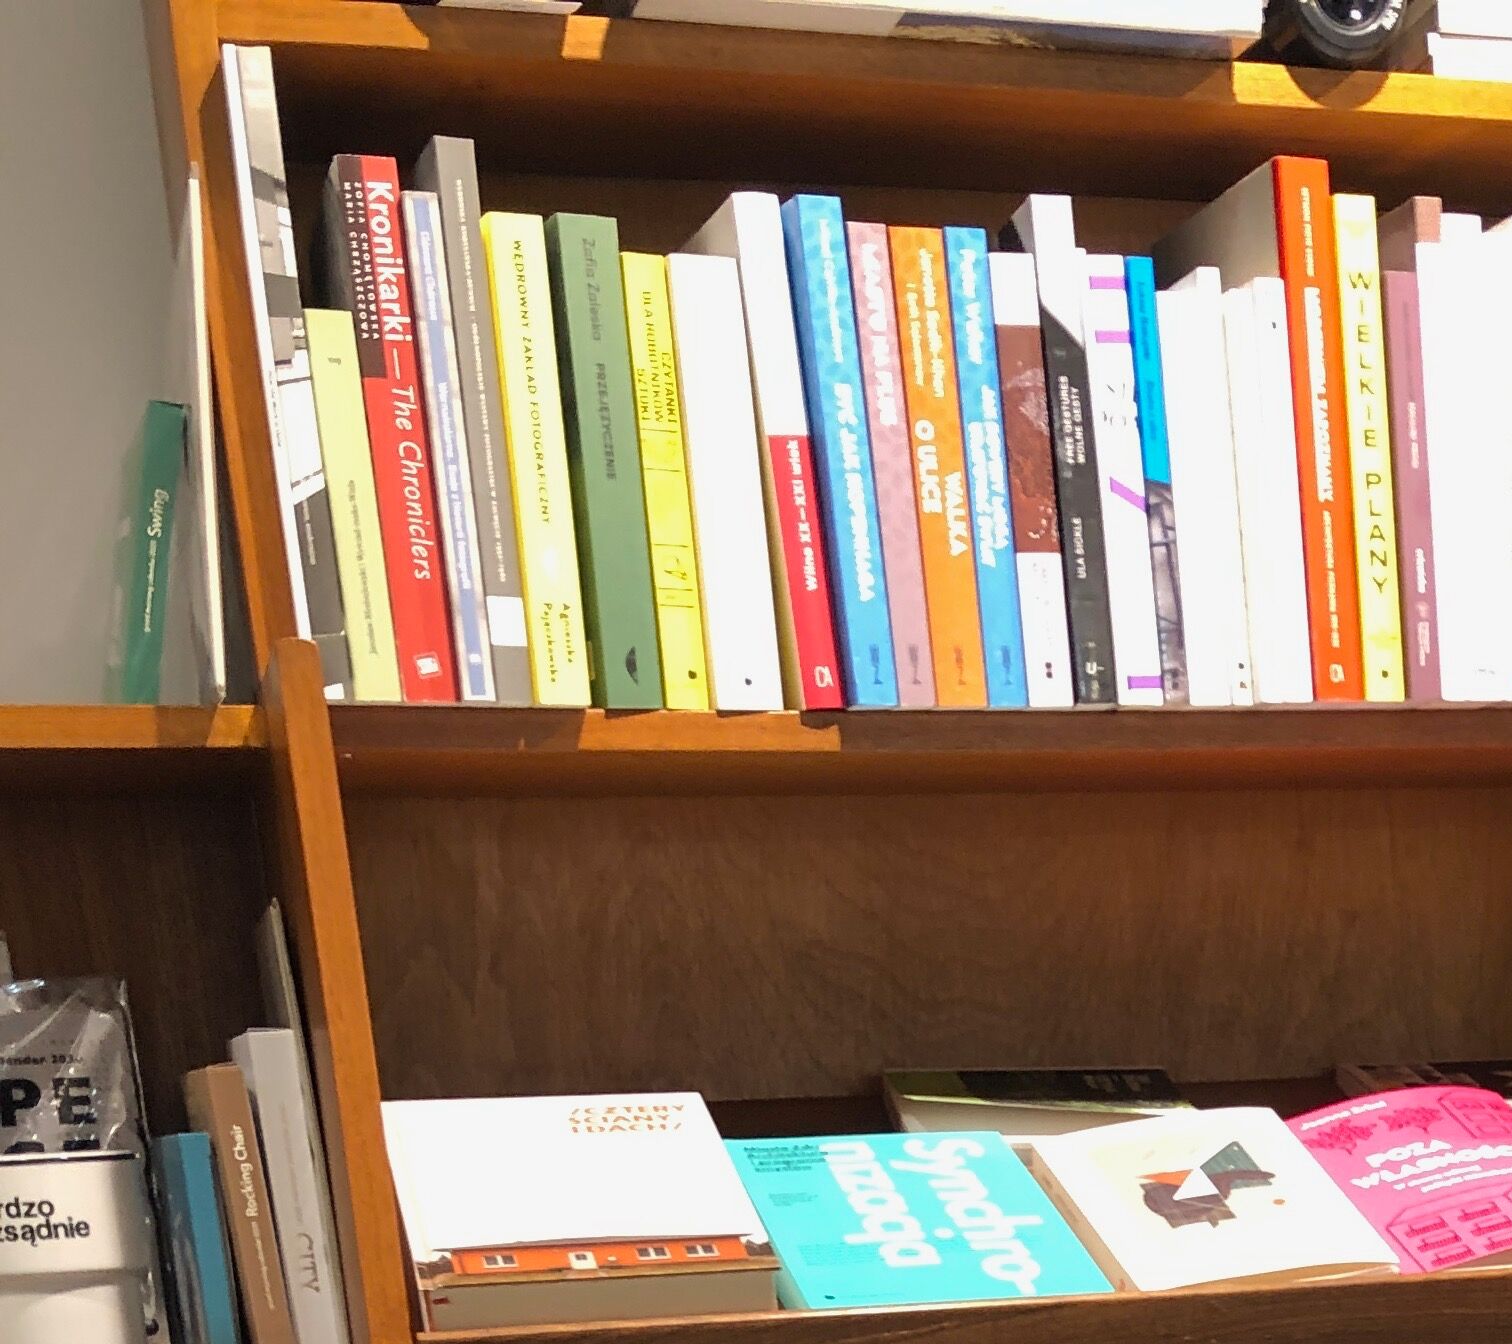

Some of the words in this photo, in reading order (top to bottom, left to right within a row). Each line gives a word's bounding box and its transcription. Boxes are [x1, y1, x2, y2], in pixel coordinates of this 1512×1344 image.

[343, 182, 355, 223] MARIA
[354, 182, 366, 223] ZOFIA
[366, 181, 413, 342] Kronikarki
[391, 385, 418, 431] The
[1058, 375, 1073, 434] GESTURES
[1070, 386, 1082, 422] GESTY
[914, 420, 935, 441] O
[1074, 423, 1086, 465] WOLNE
[1349, 272, 1377, 447] WIELKIE
[1365, 472, 1388, 594] PLANY
[917, 445, 942, 514] ULICE
[147, 488, 170, 538] Swing
[398, 441, 434, 581] Chroniclers
[945, 471, 968, 557] WALKA
[1076, 557, 1087, 579] ULA
[230, 1124, 248, 1161] Chair
[1365, 1139, 1452, 1168] POZA
[239, 1162, 259, 1217] Rocking
